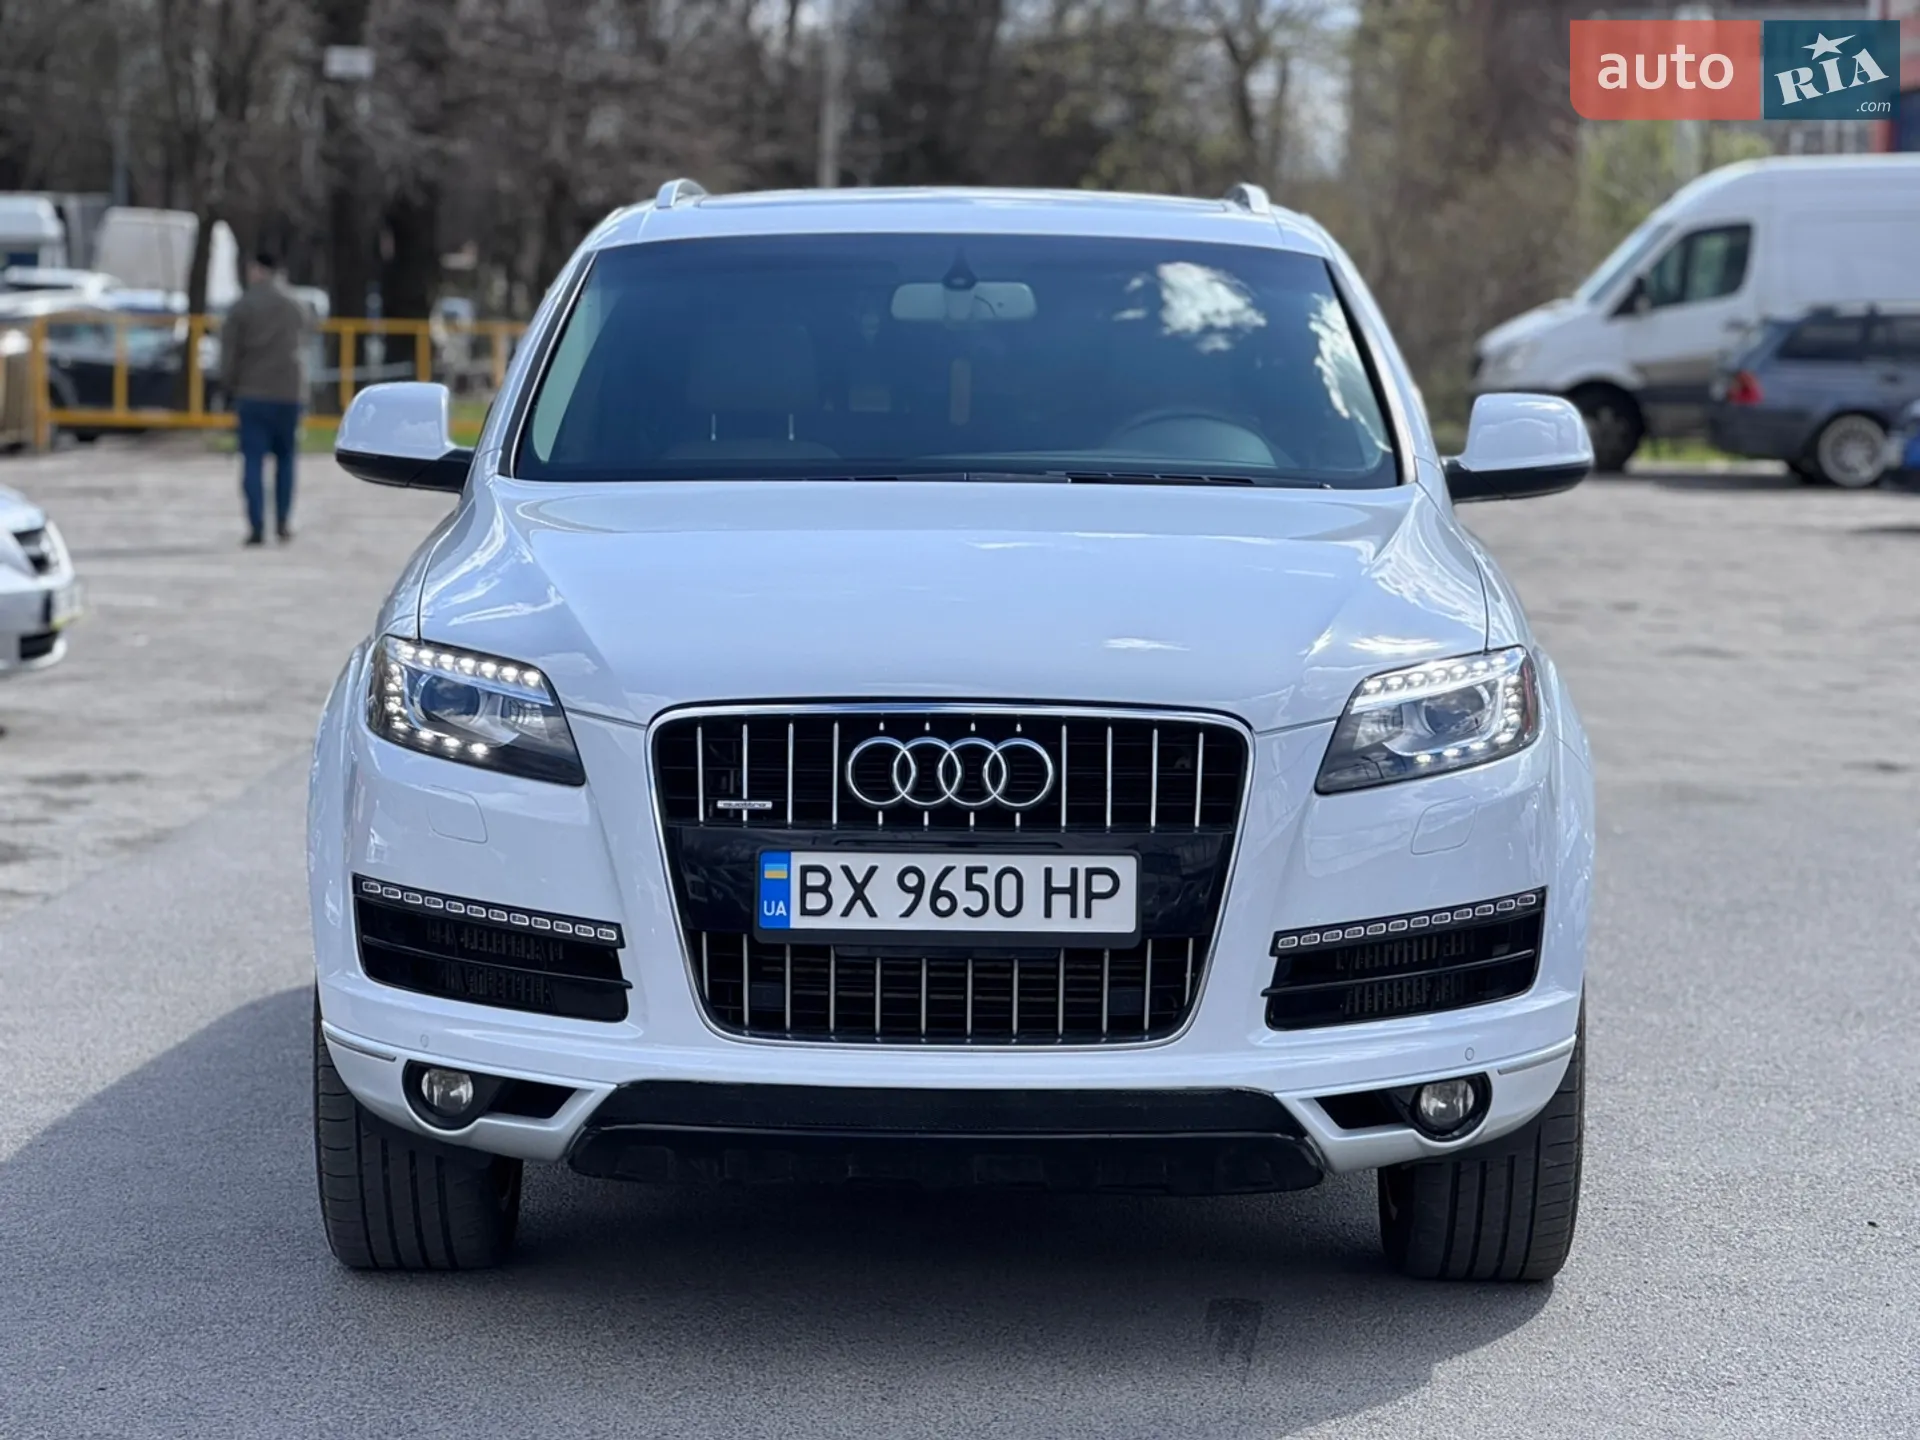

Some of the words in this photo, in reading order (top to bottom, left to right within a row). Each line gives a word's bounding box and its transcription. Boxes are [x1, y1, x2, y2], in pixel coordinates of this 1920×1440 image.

[763, 900, 787, 917] UA
[799, 864, 879, 918] BX
[896, 865, 1024, 919] 9650
[1043, 866, 1121, 919] HP
